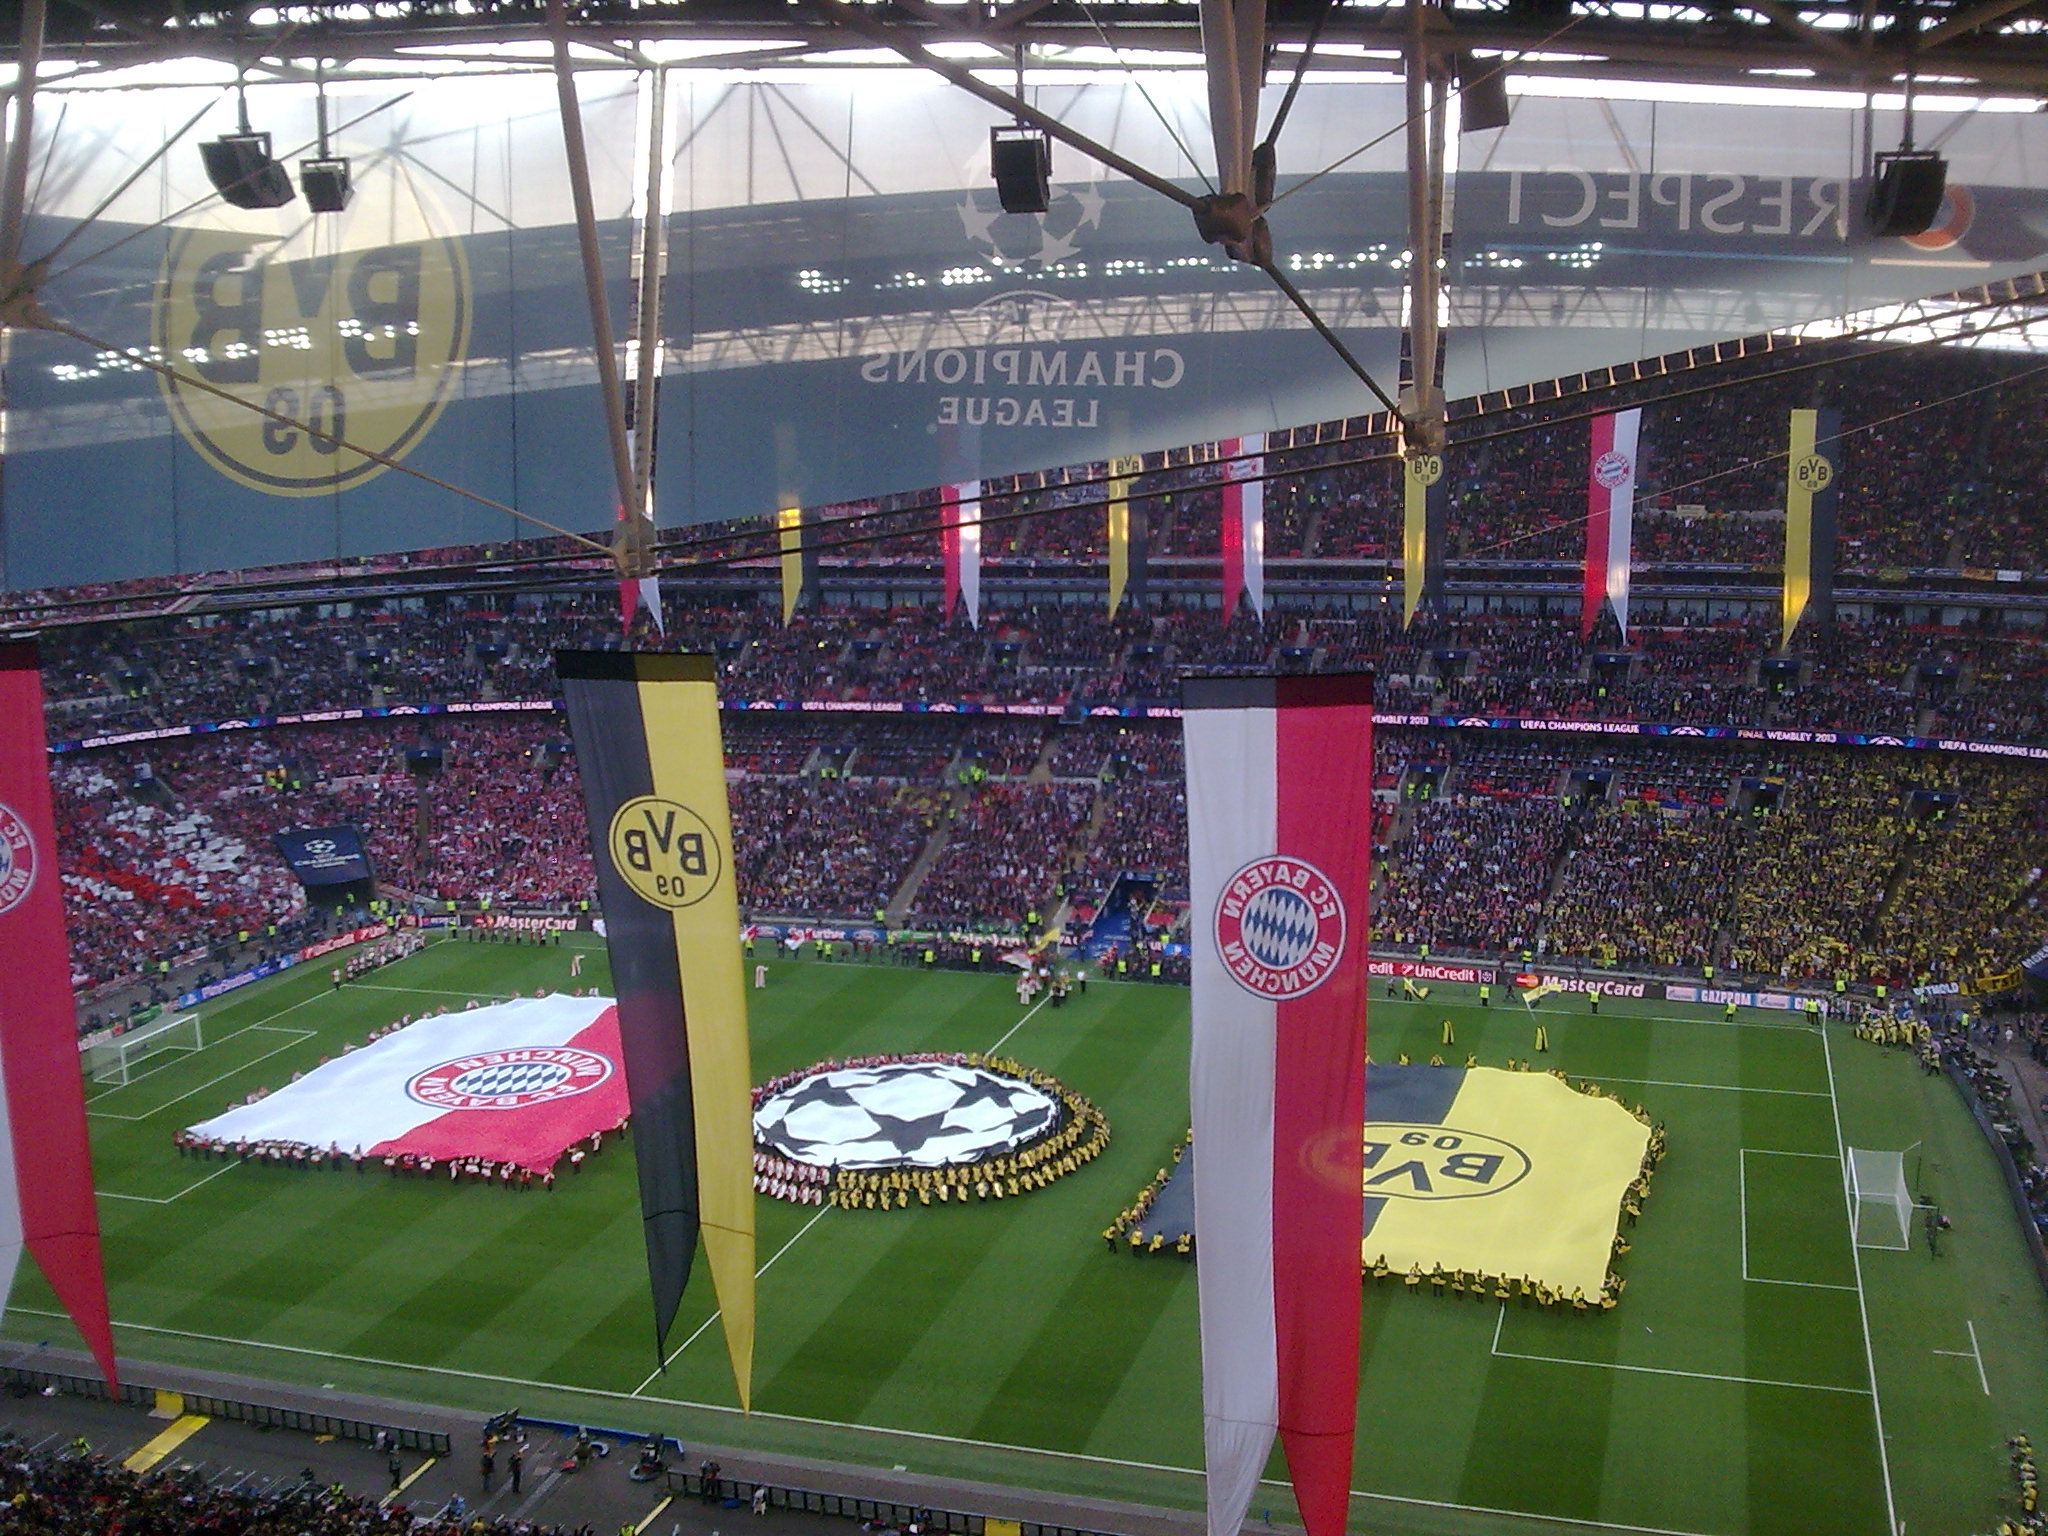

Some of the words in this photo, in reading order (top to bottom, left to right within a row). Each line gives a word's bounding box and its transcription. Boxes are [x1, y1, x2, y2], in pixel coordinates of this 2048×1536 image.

[1800, 459, 1828, 480] BVB
[1520, 720, 1546, 730] UEFA
[1547, 720, 1602, 732] CHAMPIONS
[1604, 723, 1640, 734] LEAGUE
[1737, 729, 1764, 739] FINAL
[1766, 730, 1812, 741] WEMBLEY
[1815, 733, 1837, 743] 2013
[1939, 740, 1967, 751] UEFA
[1968, 742, 2028, 756] CHAMPIONS
[494, 914, 577, 930] MasterCard
[1414, 964, 1475, 981] UniCredit
[1542, 974, 1645, 998] MasterCard
[1701, 989, 1751, 1006] GAZPROM
[418, 1076, 519, 1107] BAYERN
[531, 1084, 577, 1100] FC
[1400, 1132, 1463, 1150] 09
